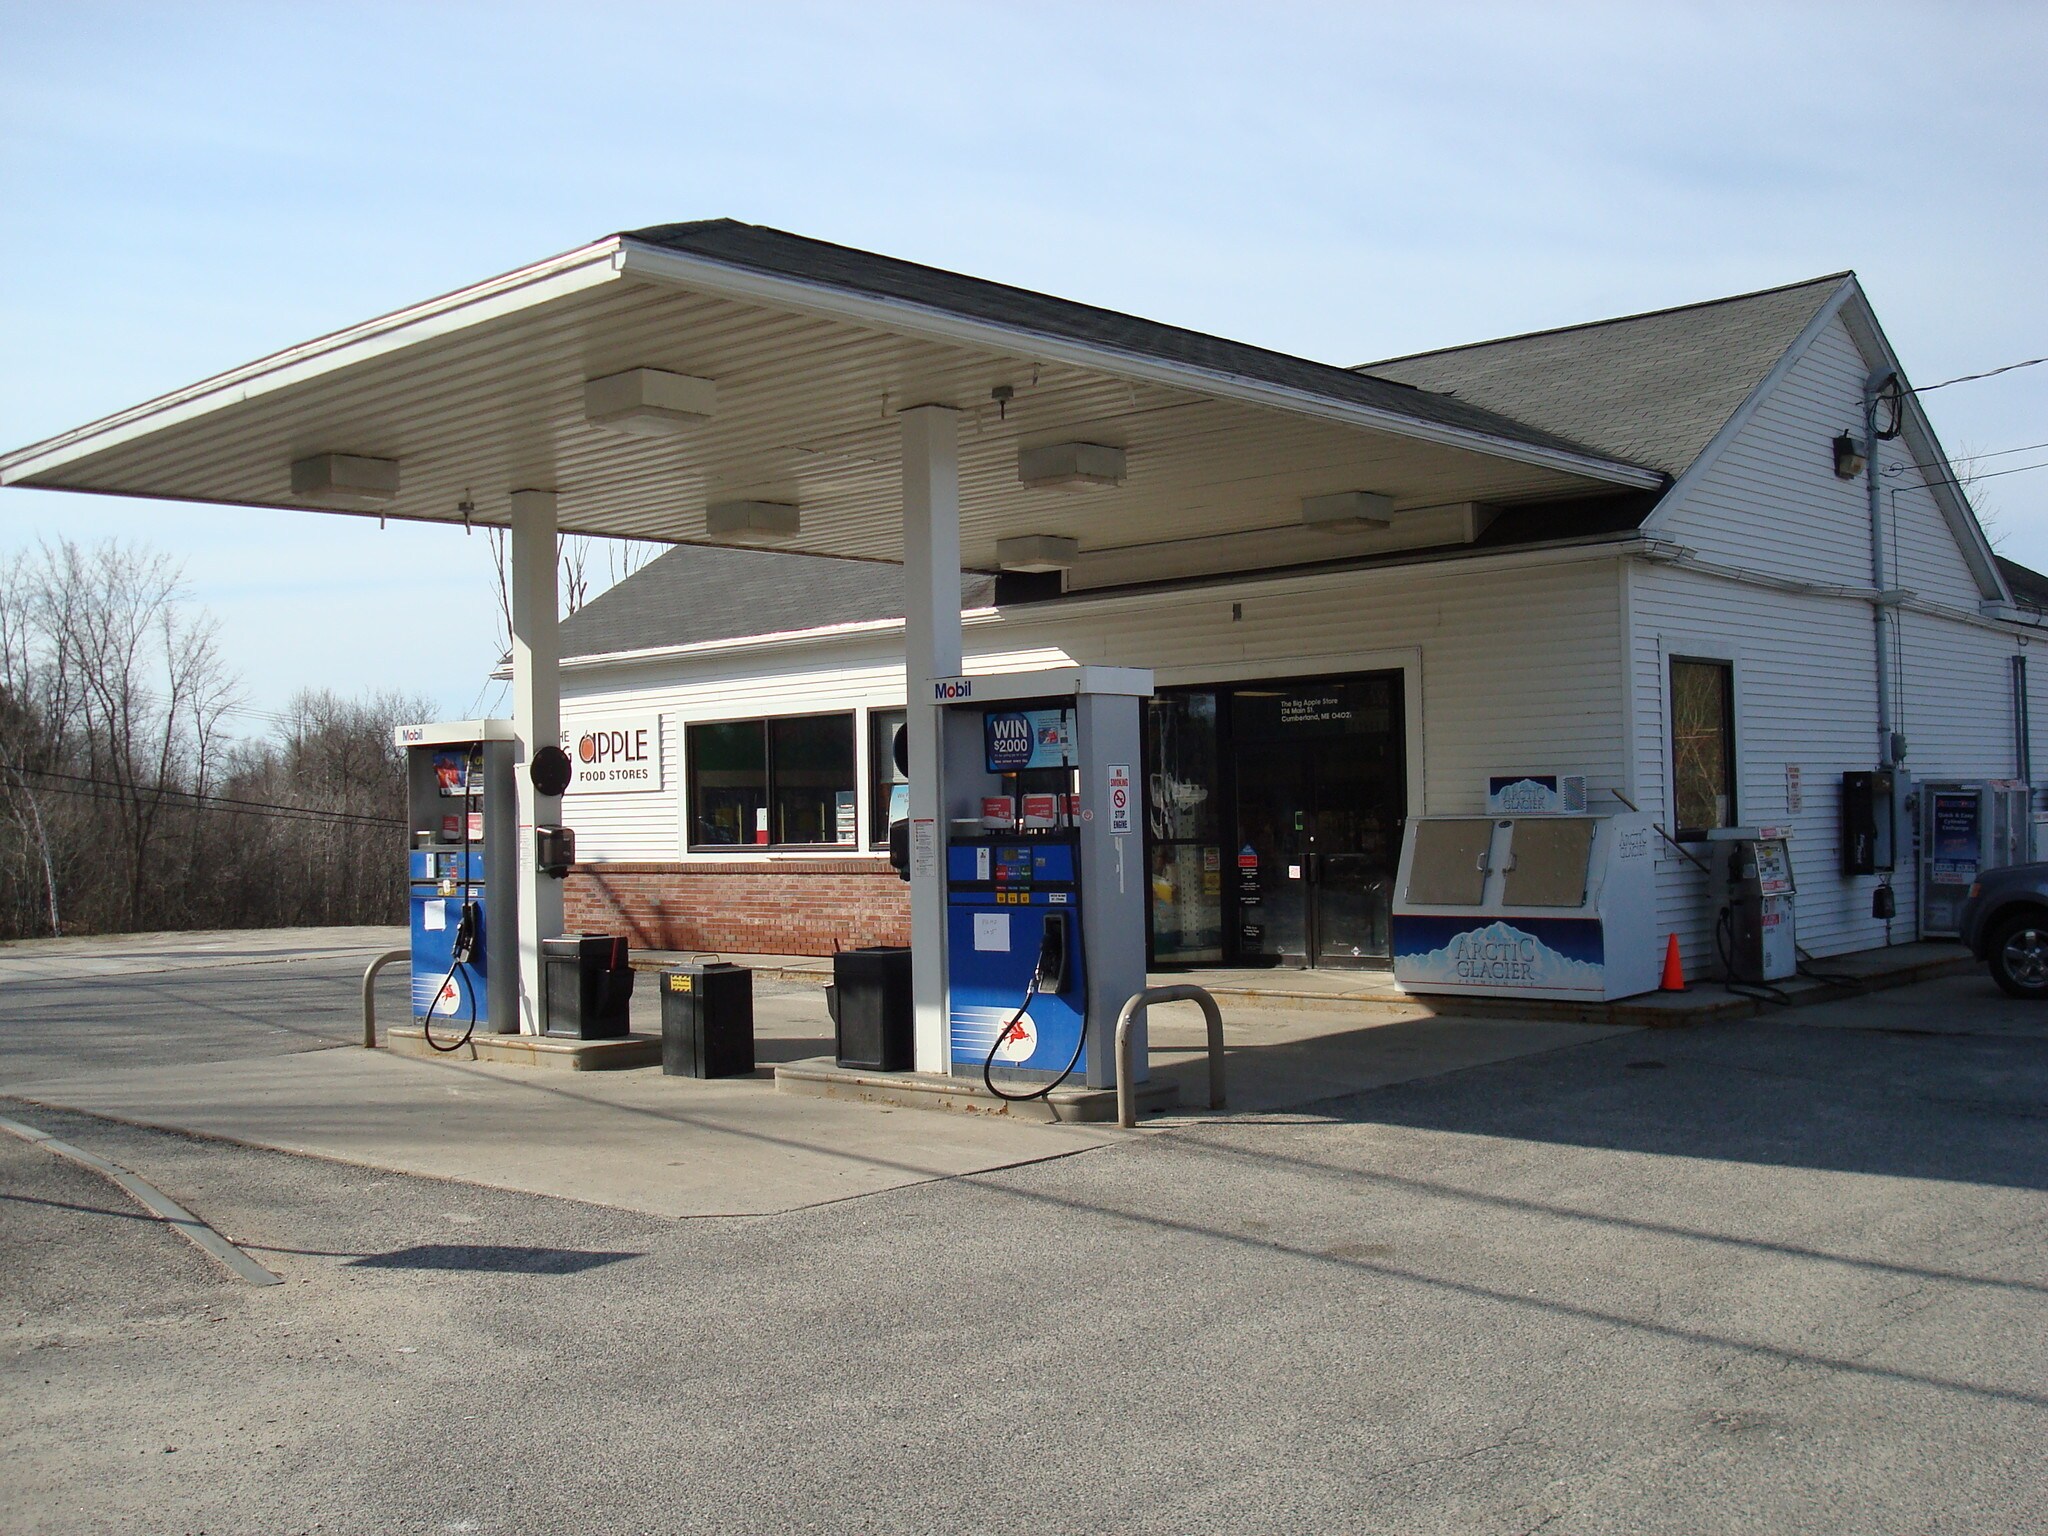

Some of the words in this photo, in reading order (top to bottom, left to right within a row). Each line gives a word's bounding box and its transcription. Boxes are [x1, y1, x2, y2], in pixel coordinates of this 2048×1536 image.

[934, 680, 972, 699] Mobil
[1303, 699, 1321, 708] Apple
[402, 728, 423, 741] Mobil
[993, 719, 1028, 739] WIN
[993, 738, 1028, 753] $2000
[580, 771, 606, 782] FOOD
[609, 769, 648, 780] STORES
[1503, 785, 1545, 800] ARCTIC
[1503, 799, 1546, 810] GLACIER
[1115, 810, 1125, 819] STOP
[1455, 936, 1535, 963] ARCTIC
[1457, 960, 1535, 980] GLACIER
